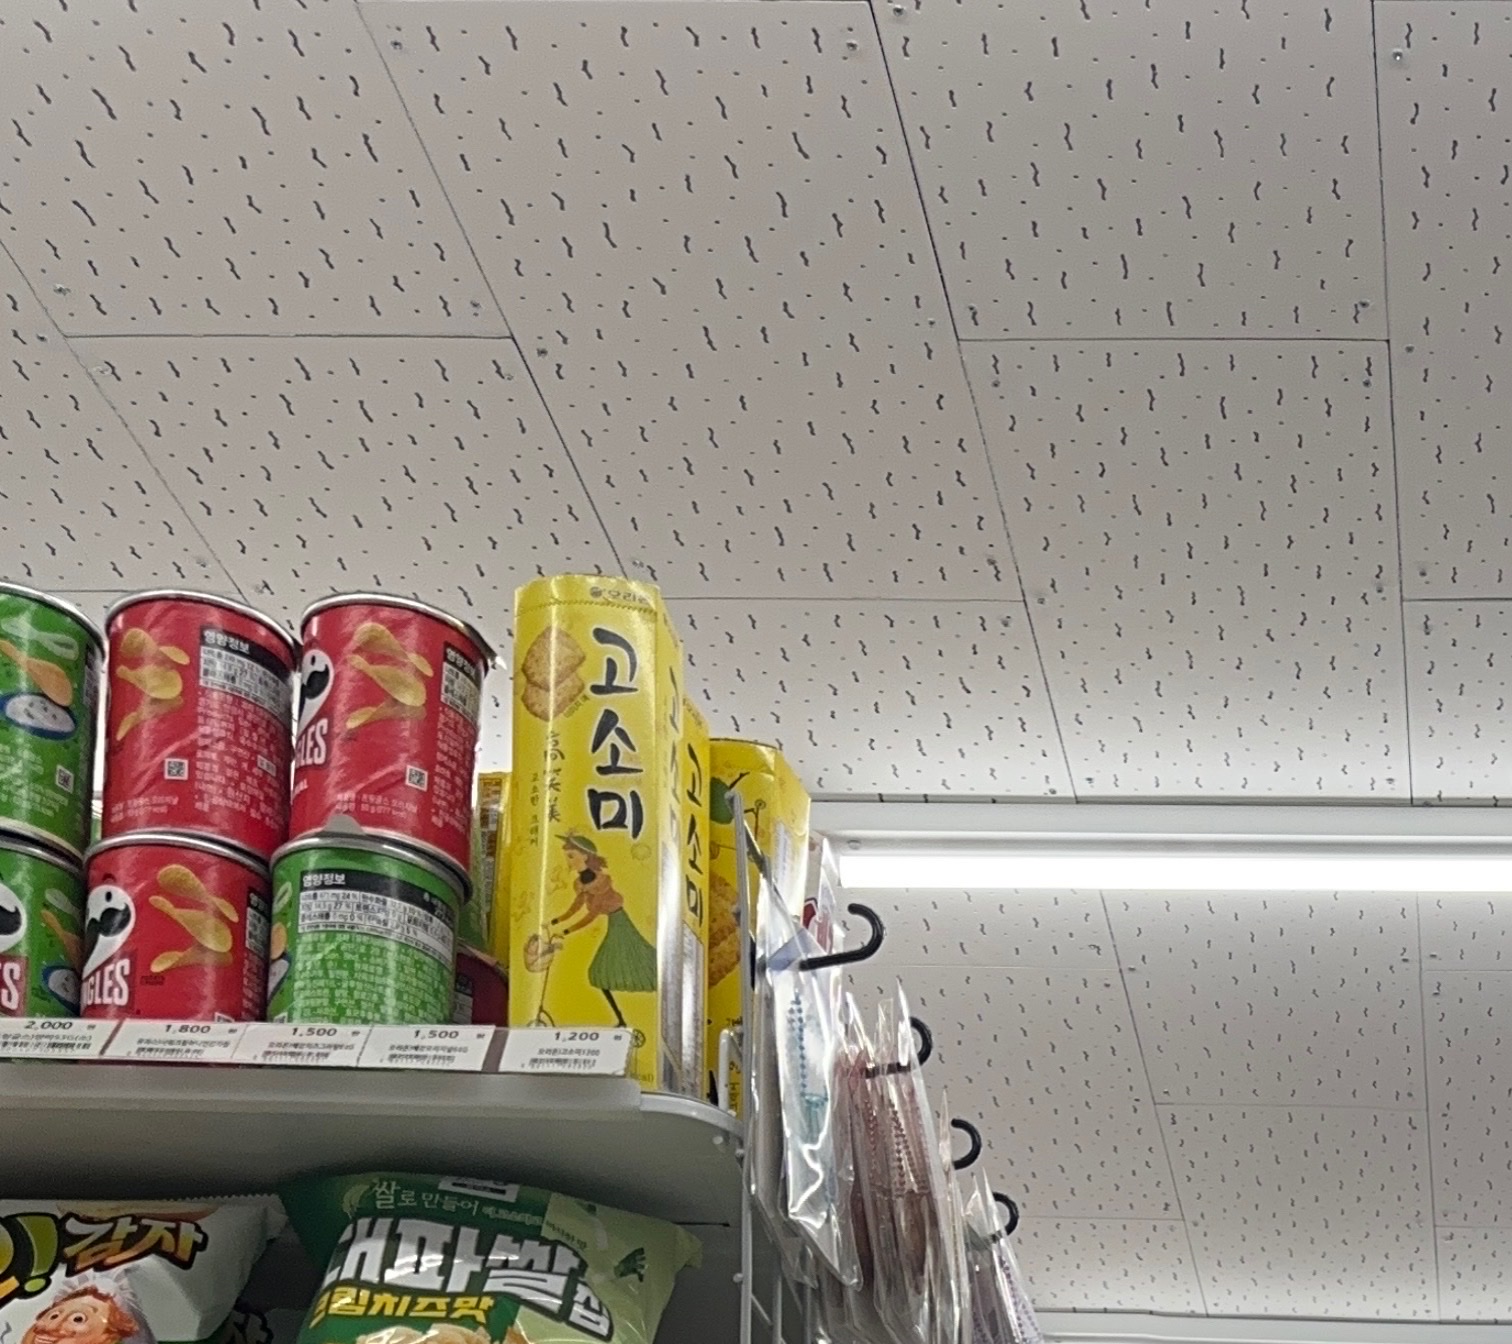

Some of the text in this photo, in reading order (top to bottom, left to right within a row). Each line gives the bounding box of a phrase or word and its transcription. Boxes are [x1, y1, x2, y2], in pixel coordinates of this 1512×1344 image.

[587, 625, 646, 841] 고소미
[301, 870, 347, 889] 영양정보
[24, 1021, 73, 1031] 2,000
[164, 1023, 211, 1035] 1,800
[291, 1026, 338, 1038] 1,500
[413, 1029, 460, 1040] 1,500
[553, 1030, 601, 1042] 1,200
[64, 1214, 207, 1275] 감자
